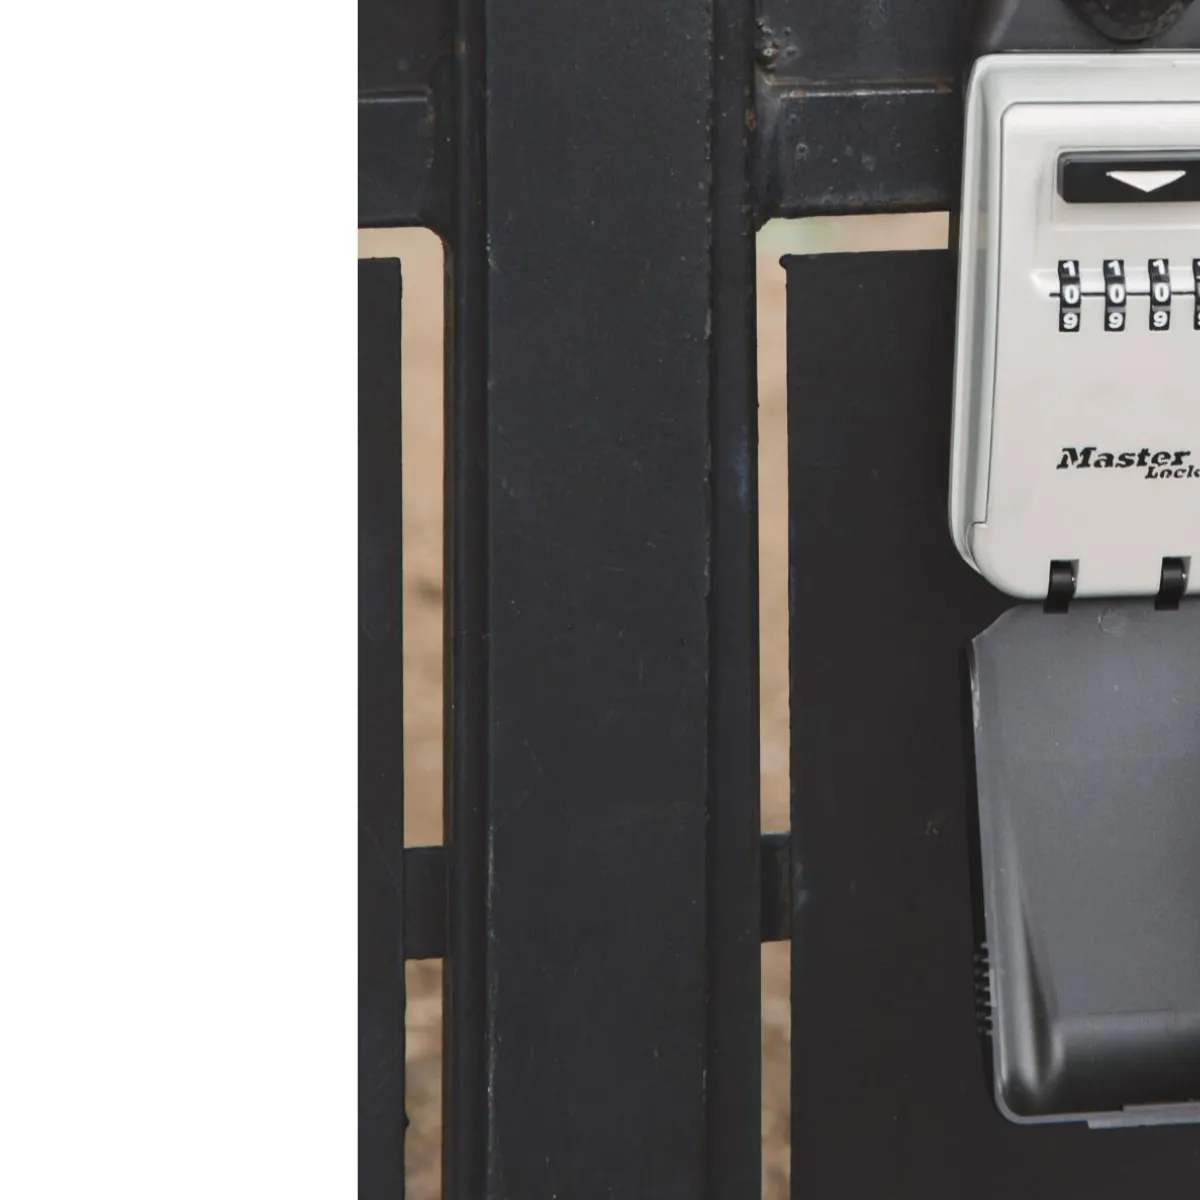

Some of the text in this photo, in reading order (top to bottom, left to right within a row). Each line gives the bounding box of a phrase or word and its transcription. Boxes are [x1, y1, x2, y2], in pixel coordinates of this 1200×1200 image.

[1064, 286, 1080, 304] 0
[1109, 286, 1125, 304] 0
[1154, 285, 1170, 302] 0
[1063, 313, 1078, 329] 9
[1108, 312, 1123, 328] 9
[1153, 311, 1168, 327] 9
[1056, 447, 1191, 470] Master
[1145, 465, 1200, 479] Lock
